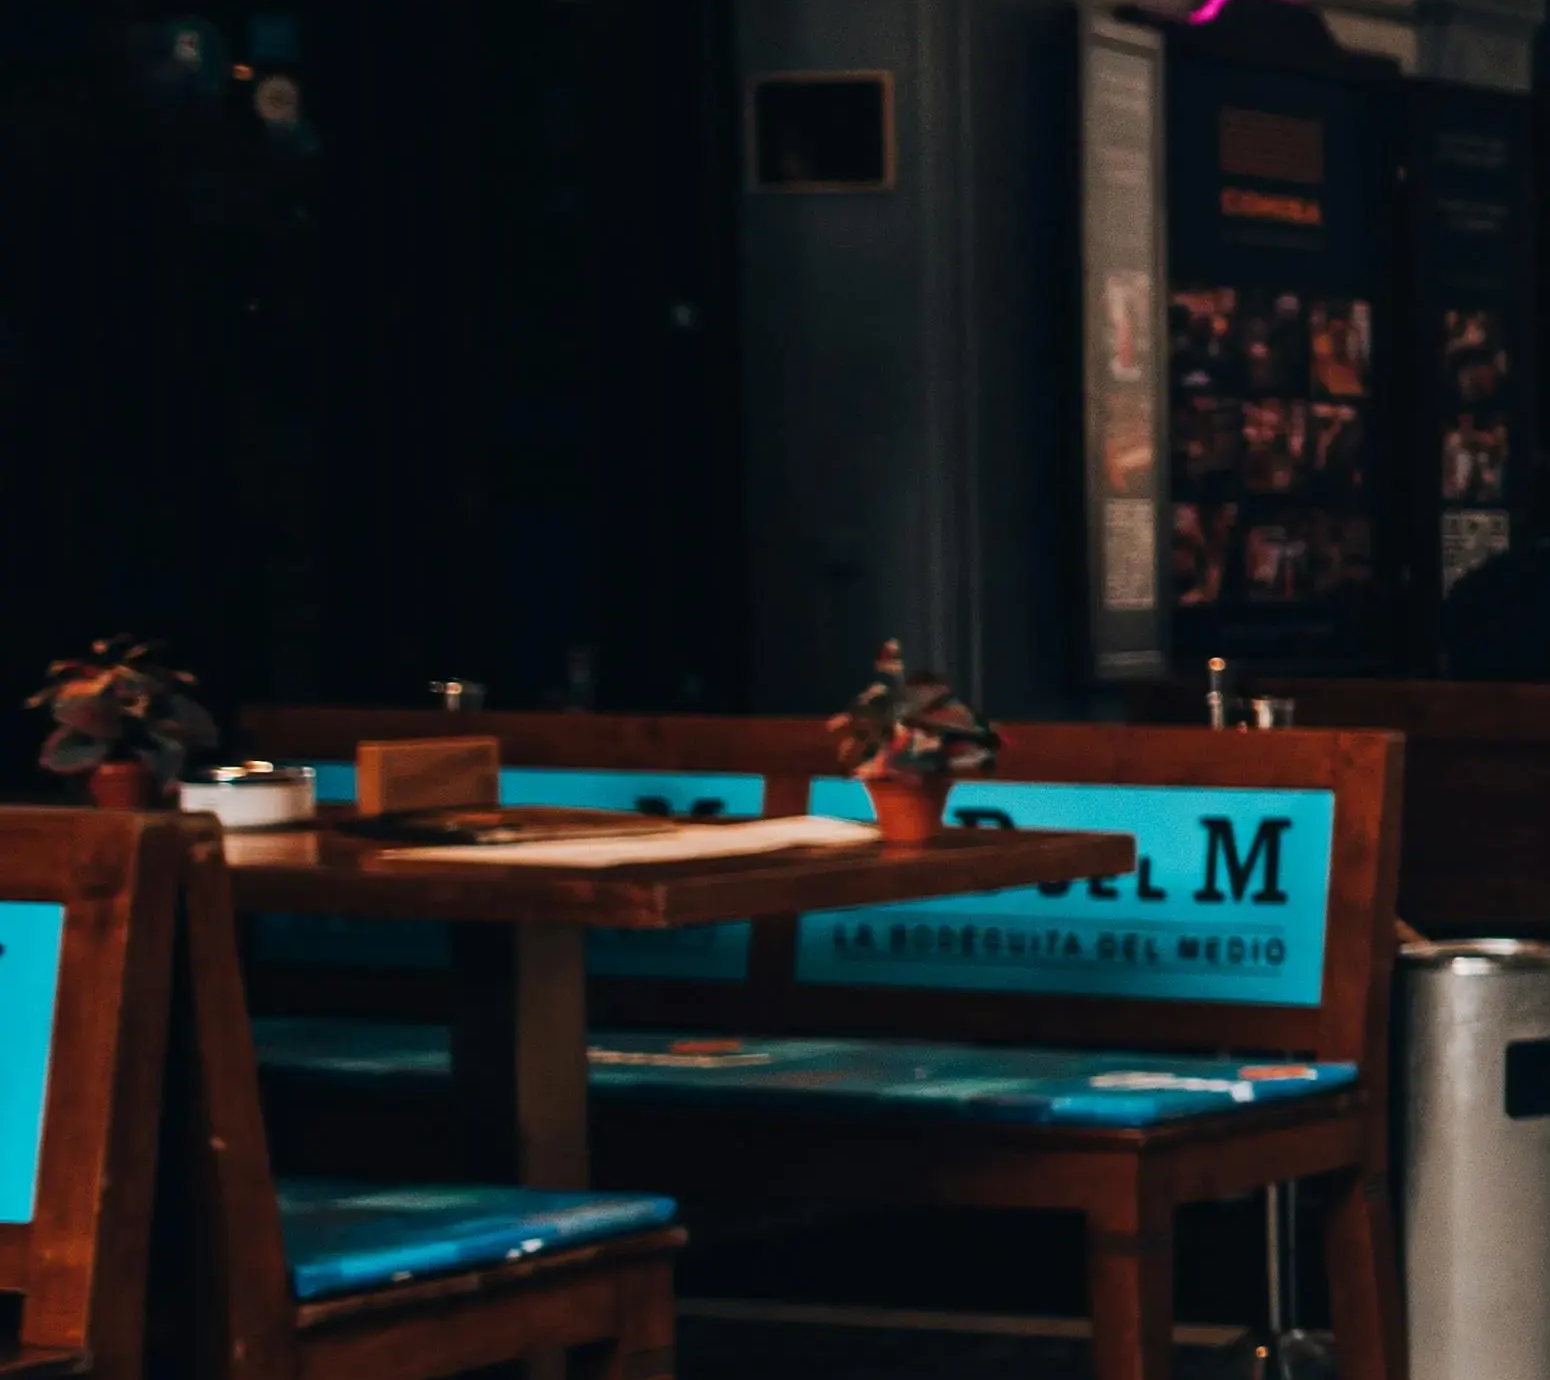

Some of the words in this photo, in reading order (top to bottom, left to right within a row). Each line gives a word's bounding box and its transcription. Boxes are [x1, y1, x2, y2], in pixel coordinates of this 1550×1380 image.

[1194, 816, 1294, 905] M
[833, 924, 877, 953] LA
[889, 926, 1083, 958] BODEGUITA
[1095, 932, 1160, 963] DEL
[1176, 936, 1287, 966] MEDIO
